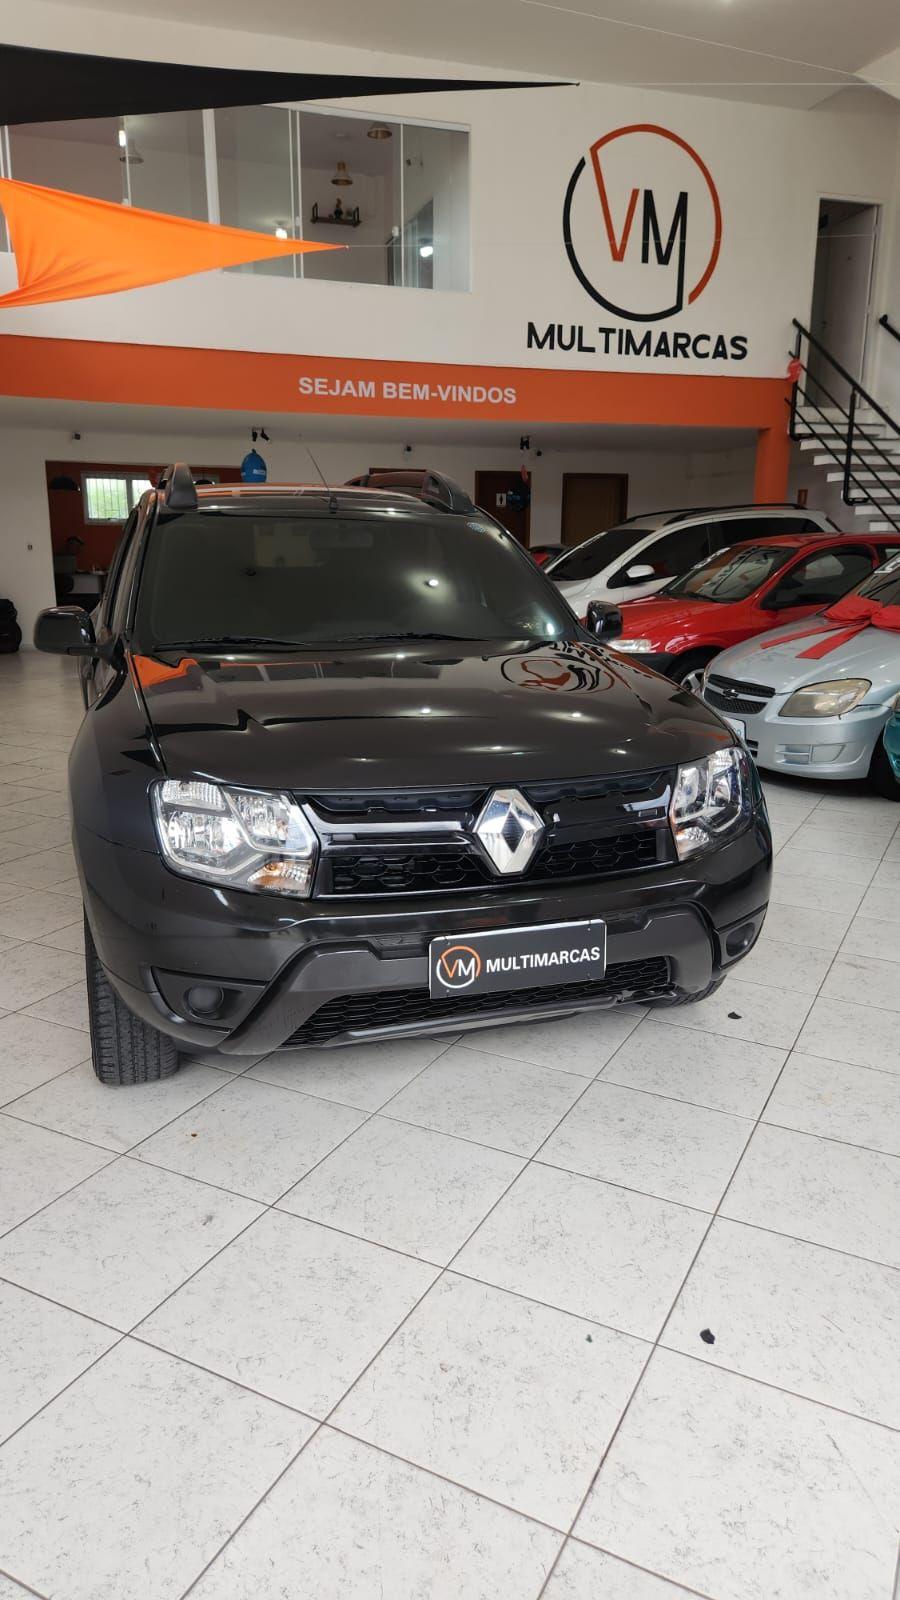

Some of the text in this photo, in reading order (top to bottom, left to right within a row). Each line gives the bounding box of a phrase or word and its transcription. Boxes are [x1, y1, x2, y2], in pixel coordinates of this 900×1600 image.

[527, 322, 748, 360] MULTIMARCAS
[298, 377, 517, 404] SEJAM BEM-VINDOS
[486, 947, 600, 973] MULTIMARCAS
